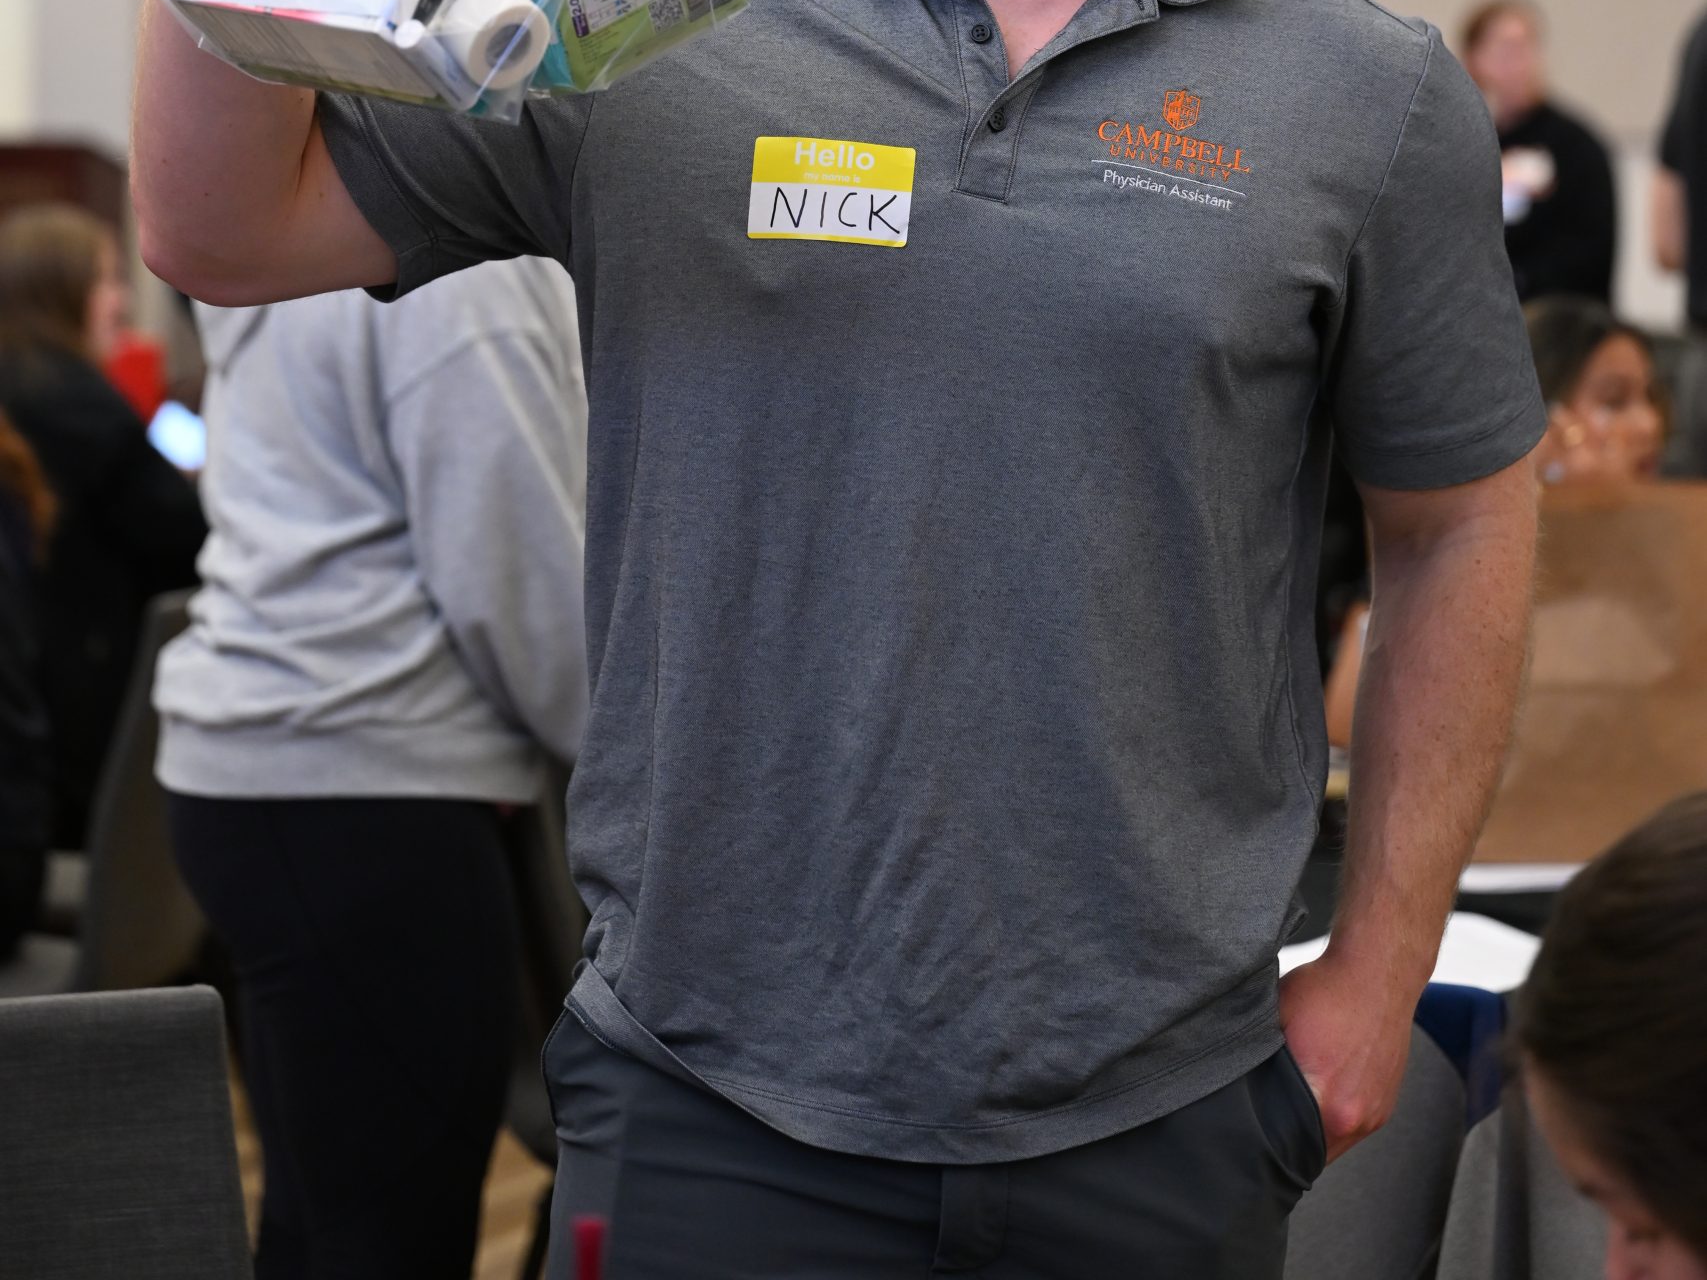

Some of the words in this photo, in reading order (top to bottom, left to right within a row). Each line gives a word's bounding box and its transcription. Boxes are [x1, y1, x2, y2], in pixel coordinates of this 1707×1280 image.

[794, 141, 875, 170] Hello
[1098, 120, 1251, 173] CAMPBELL
[1110, 144, 1232, 183] UNIVERSITY
[803, 171, 819, 182] my
[821, 173, 850, 183] name
[1103, 169, 1166, 194] Physician
[1168, 184, 1233, 211] Assistant
[770, 186, 901, 234] NICK
